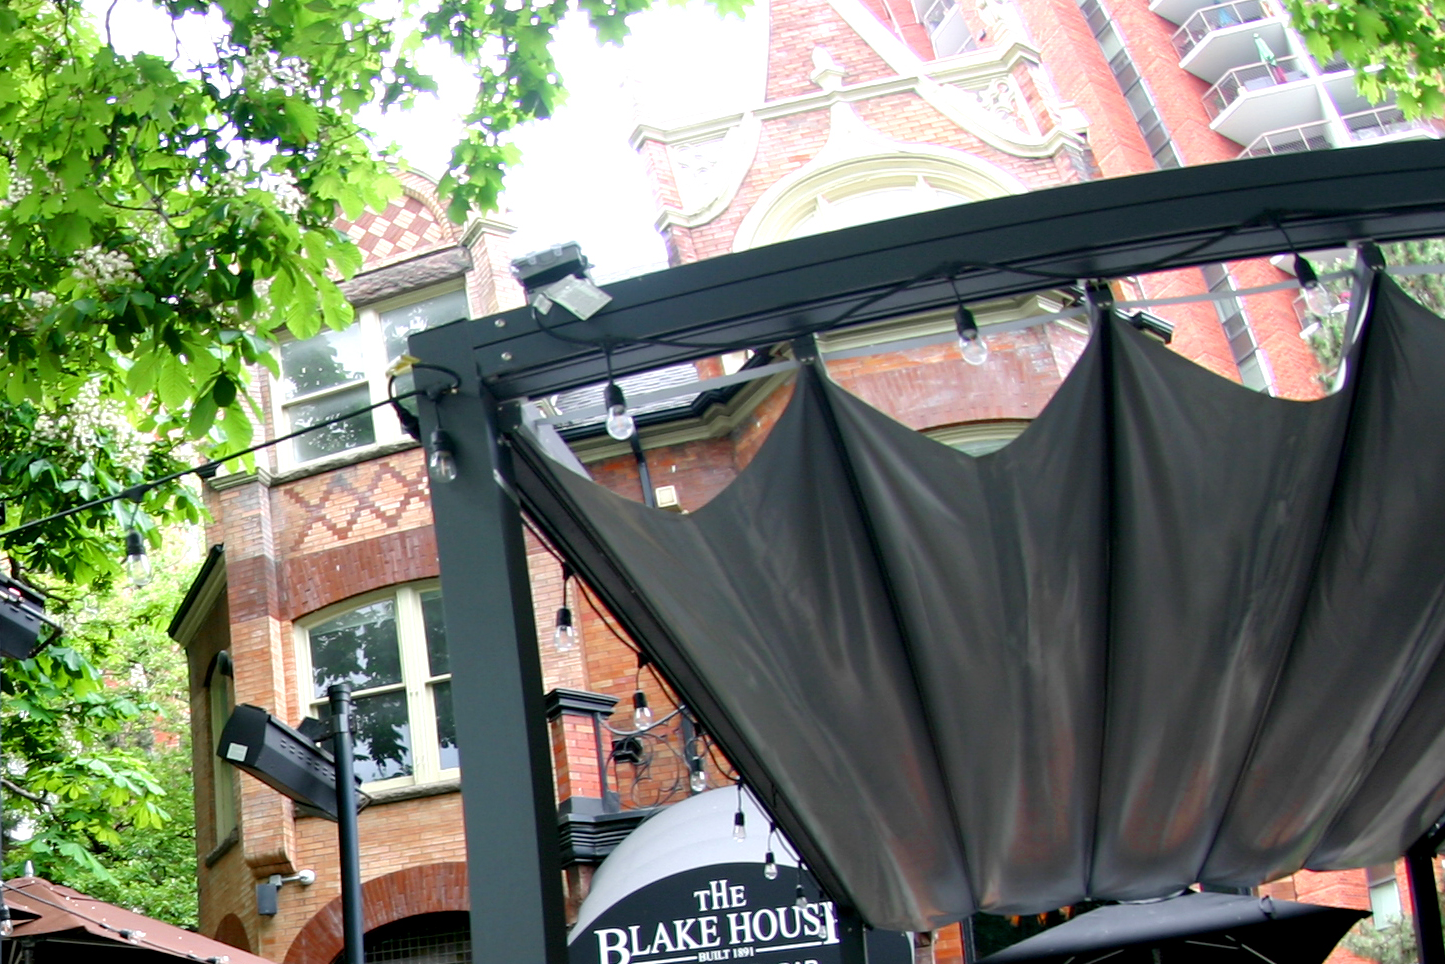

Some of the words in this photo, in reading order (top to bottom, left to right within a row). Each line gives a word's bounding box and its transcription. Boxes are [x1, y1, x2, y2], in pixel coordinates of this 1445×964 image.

[693, 879, 747, 912] THE
[698, 949, 731, 963] BUILT
[732, 946, 755, 959] 1891
